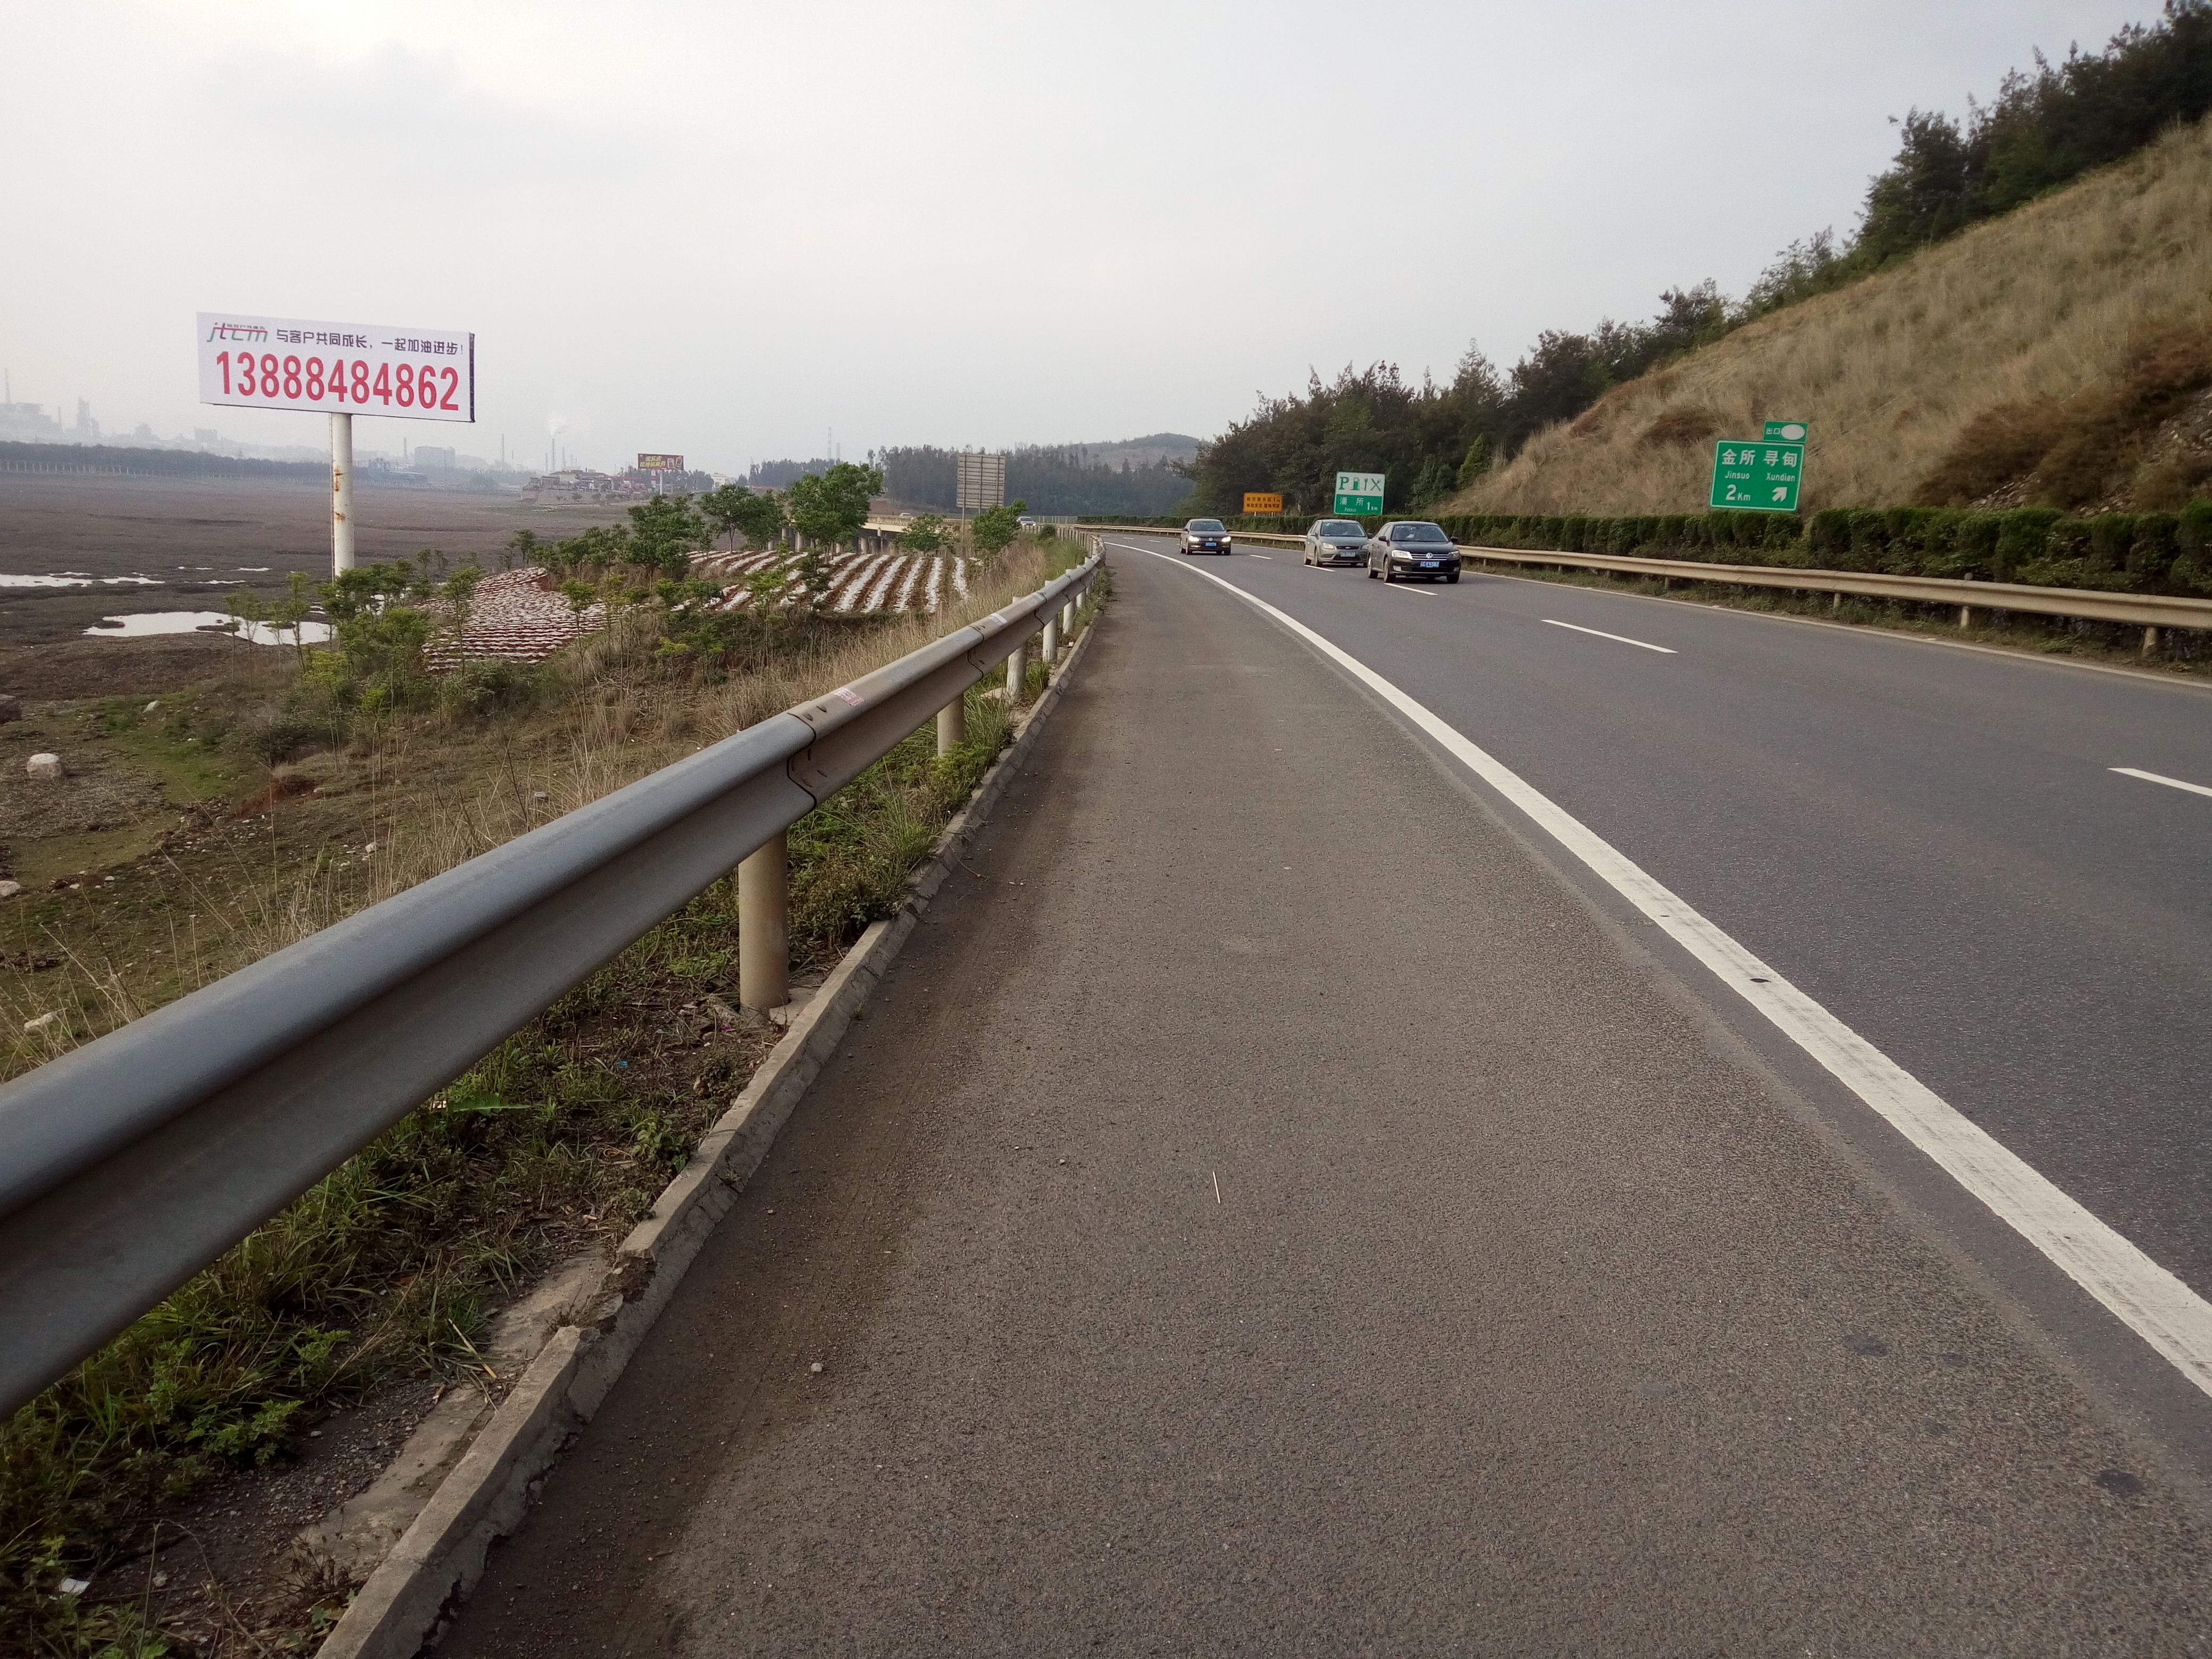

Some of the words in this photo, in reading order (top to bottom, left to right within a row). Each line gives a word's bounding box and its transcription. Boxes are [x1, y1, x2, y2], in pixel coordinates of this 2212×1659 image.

[216, 351, 459, 411] 13888484862
[1722, 448, 1756, 466] 金所
[1763, 450, 1798, 467] 寻甸
[1724, 471, 1750, 479] Jinsuo
[1766, 472, 1796, 482] Xundian
